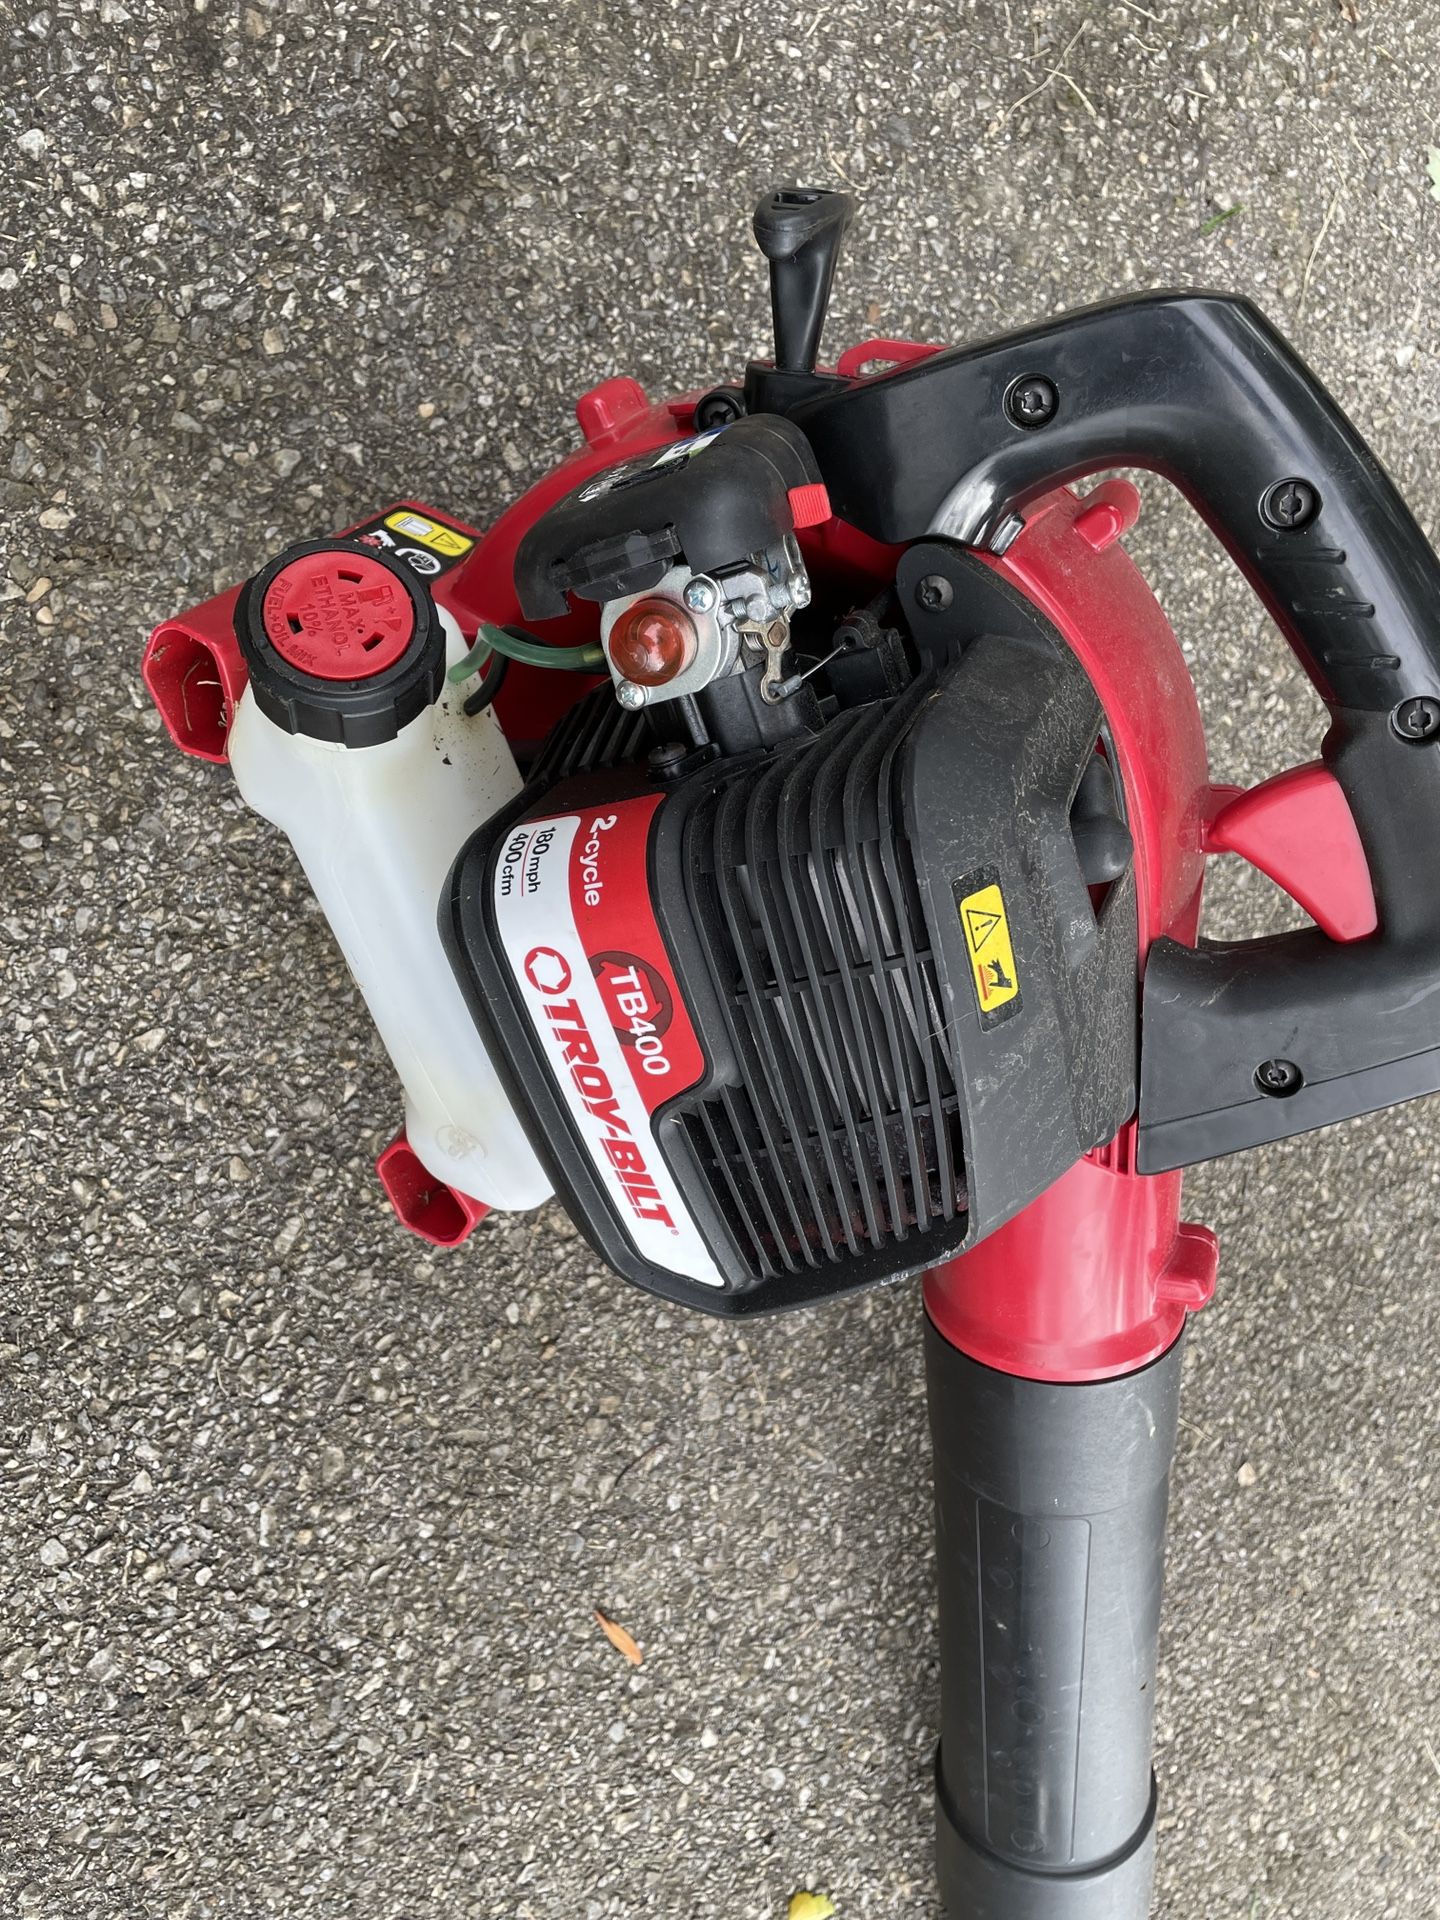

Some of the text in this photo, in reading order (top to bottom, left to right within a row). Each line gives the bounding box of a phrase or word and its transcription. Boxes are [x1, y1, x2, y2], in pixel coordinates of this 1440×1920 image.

[300, 603, 324, 637] 10%
[311, 575, 351, 657] ETHANOL
[501, 832, 529, 896] 400 cfm
[525, 826, 557, 893] 180 mph
[578, 814, 617, 906] 2-cycle
[609, 965, 671, 1075] TB400
